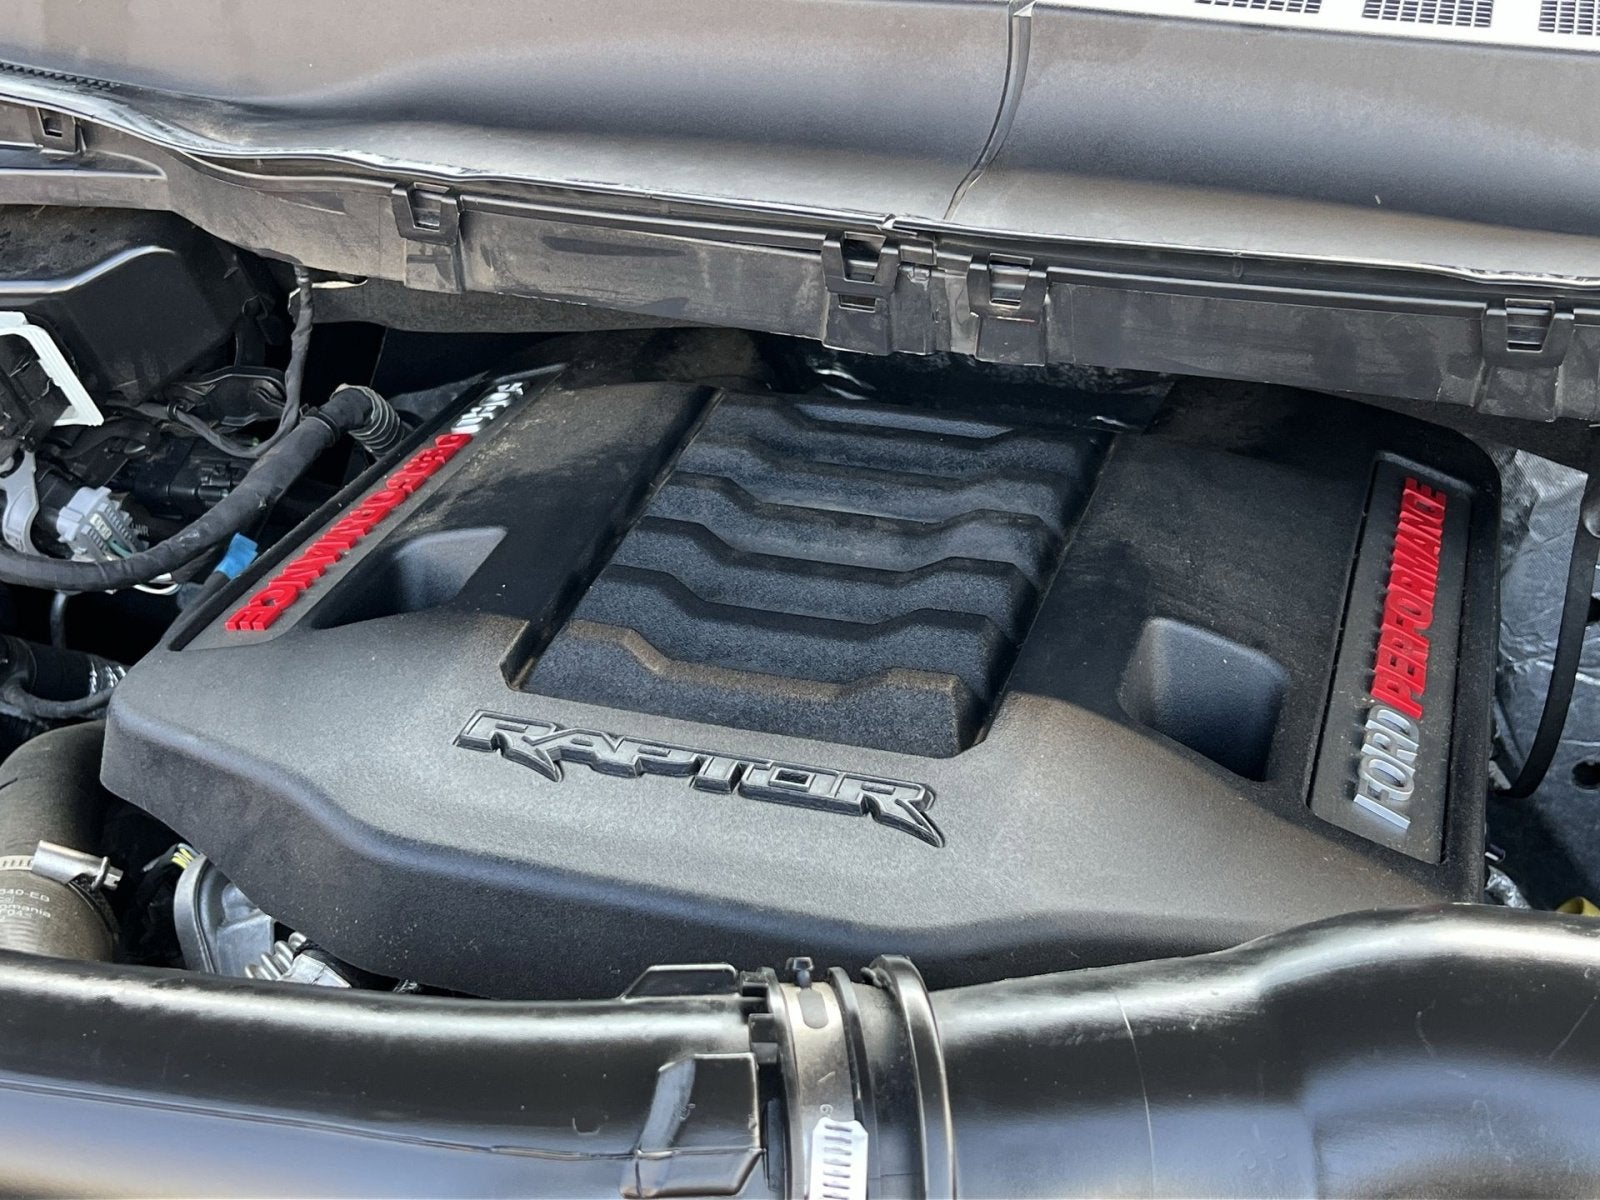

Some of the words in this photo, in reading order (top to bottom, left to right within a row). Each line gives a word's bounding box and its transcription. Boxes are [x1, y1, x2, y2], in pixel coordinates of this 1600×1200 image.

[225, 432, 474, 631] PERFORMANCE
[1370, 476, 1447, 720] PERFORMANCE
[453, 708, 946, 849] RAPTOR
[1353, 704, 1420, 830] FORD
